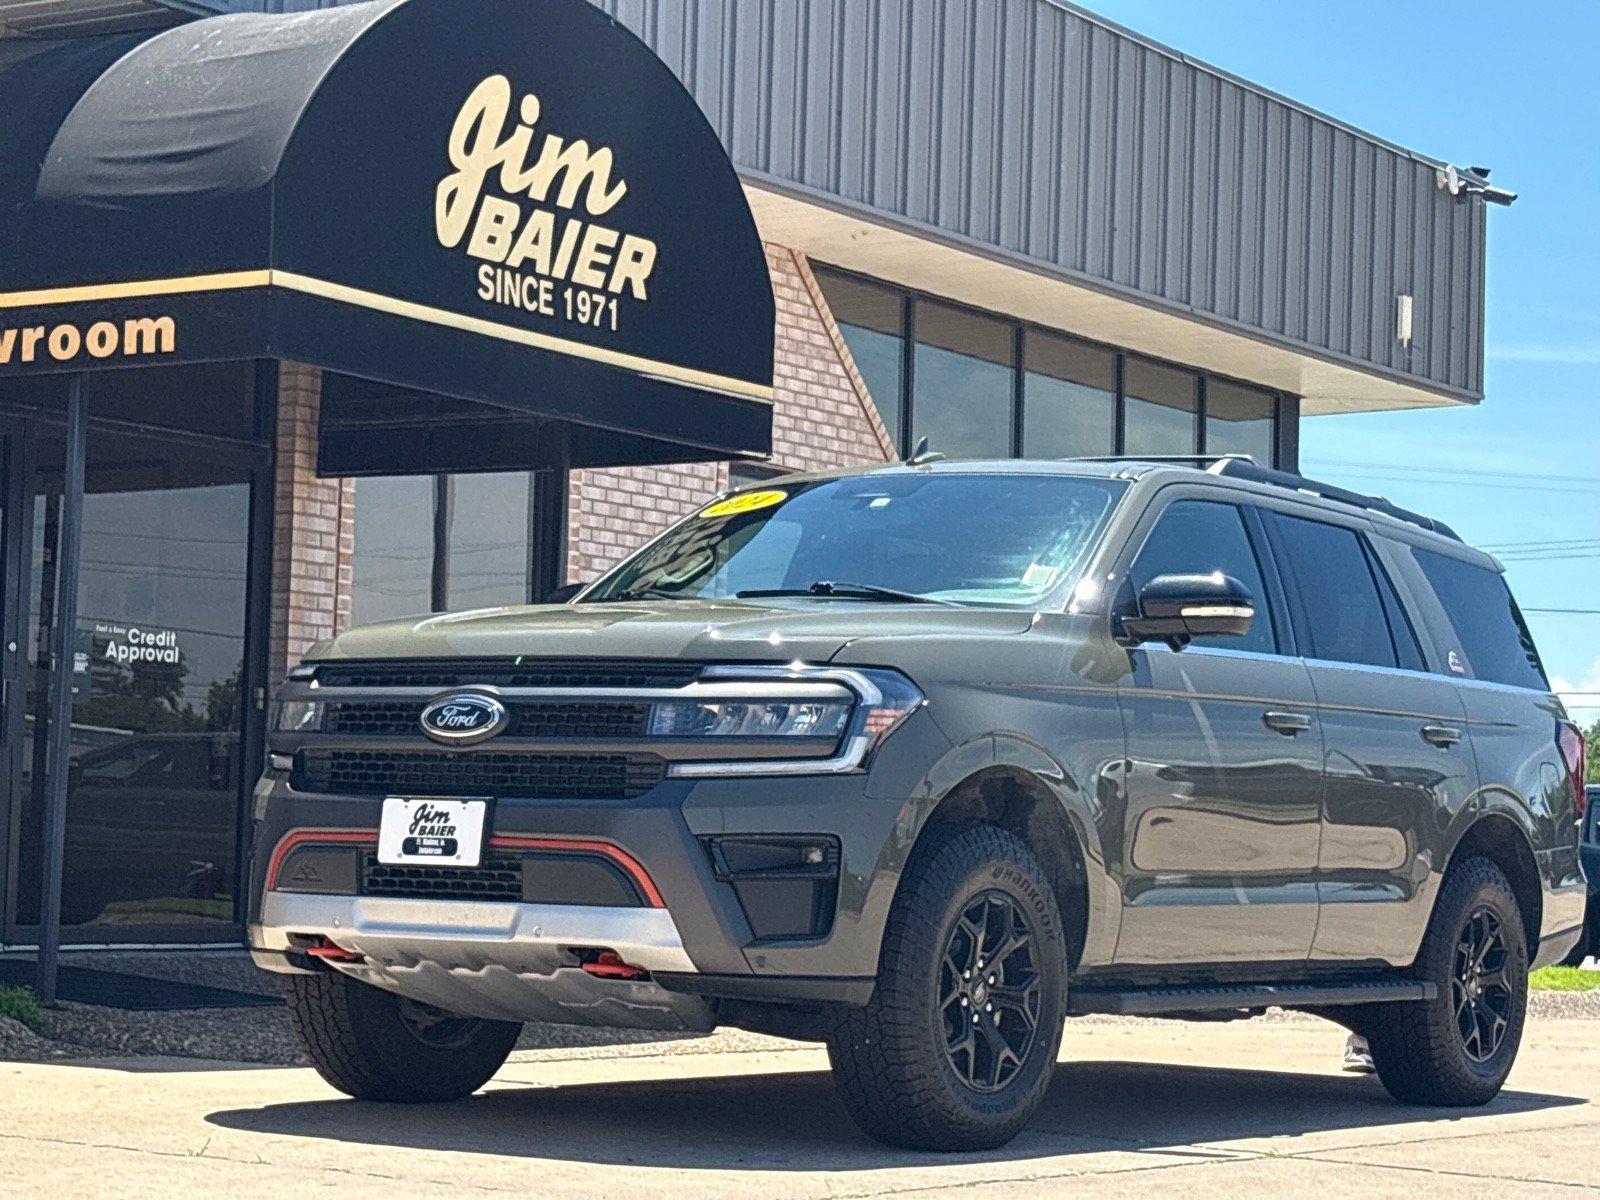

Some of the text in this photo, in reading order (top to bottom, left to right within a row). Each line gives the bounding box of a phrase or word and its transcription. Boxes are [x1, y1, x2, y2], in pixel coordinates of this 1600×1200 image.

[436, 74, 627, 248] Jim
[466, 194, 657, 300] BAIER
[477, 264, 618, 331] SINCE 1971
[128, 628, 176, 647] Credit
[105, 641, 179, 663] Approval
[436, 705, 480, 727] Ford
[408, 803, 451, 835] Jim
[417, 825, 457, 837] BAIER
